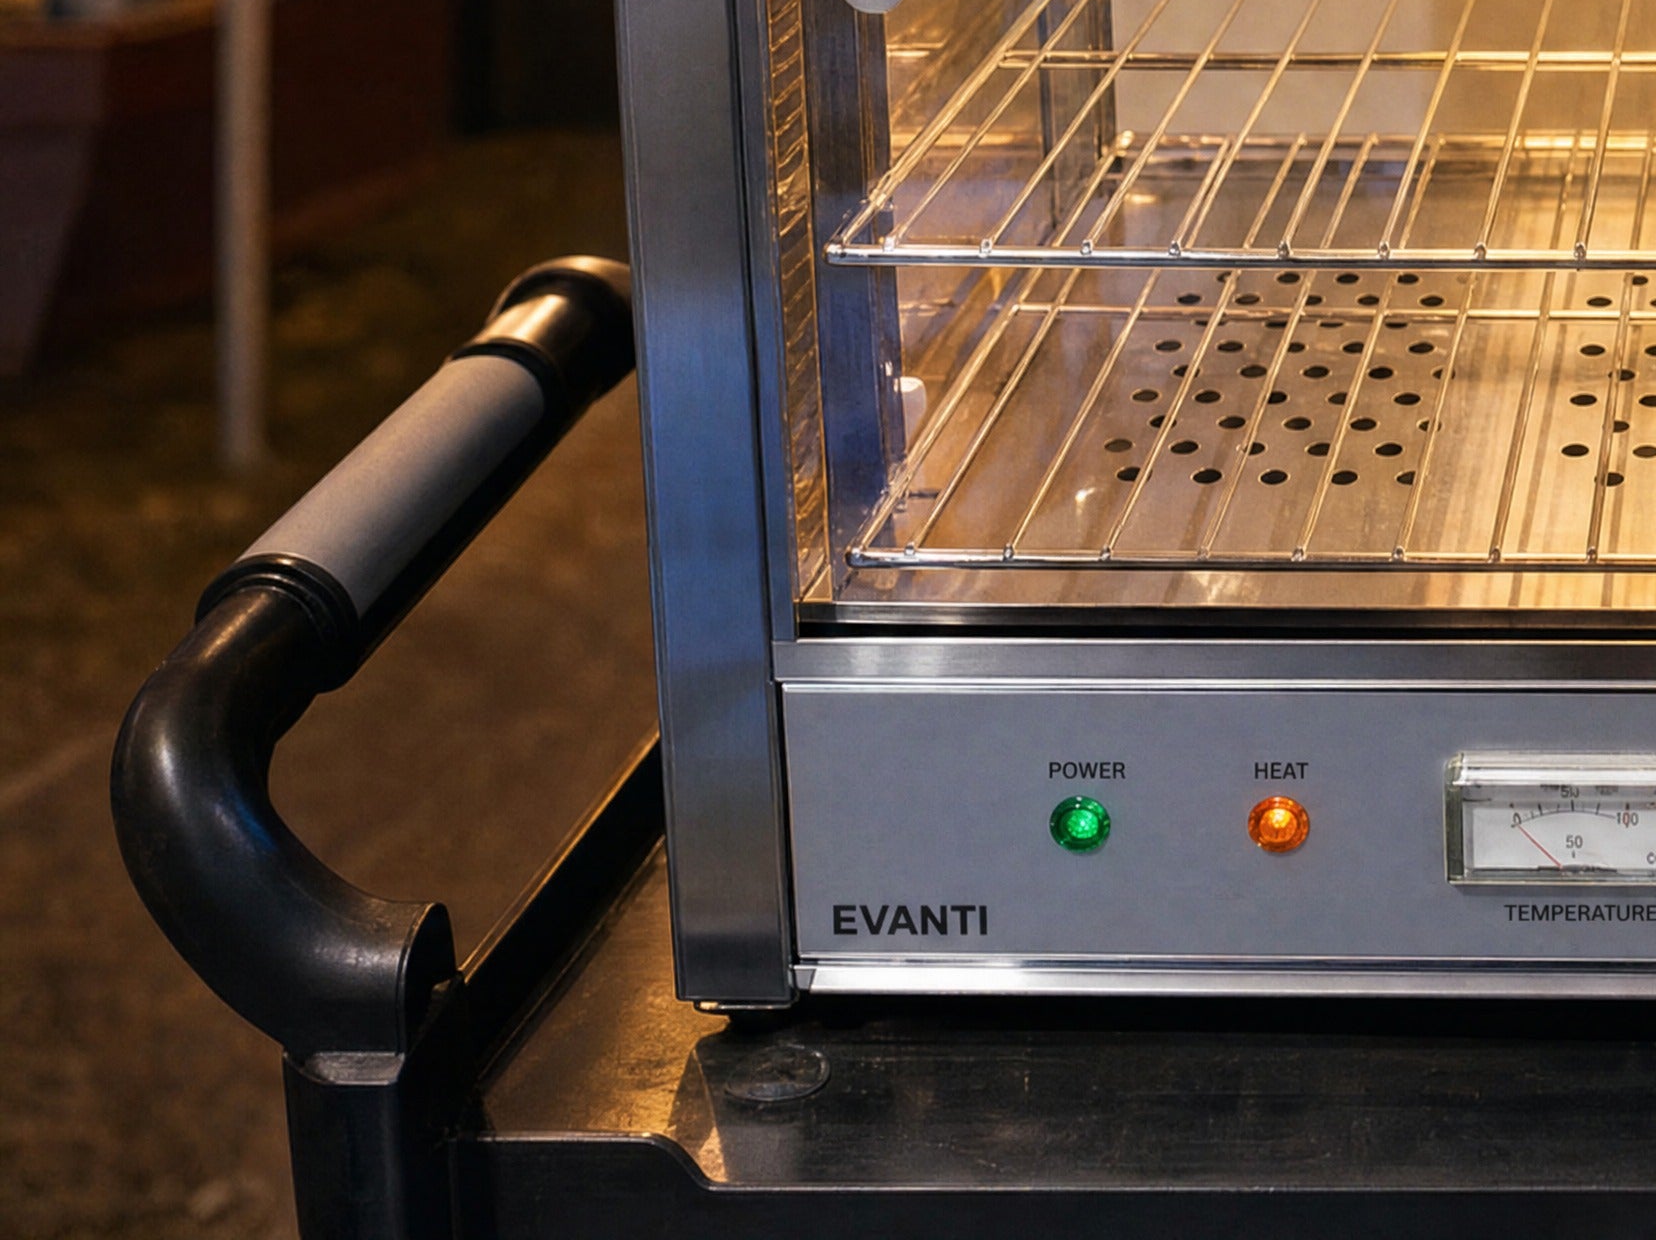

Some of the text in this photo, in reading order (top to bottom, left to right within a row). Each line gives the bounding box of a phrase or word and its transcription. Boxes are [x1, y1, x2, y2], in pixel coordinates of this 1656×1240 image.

[1048, 761, 1126, 780] POWER
[1254, 761, 1309, 780] HEAT
[1616, 812, 1639, 827] 100
[1565, 834, 1583, 849] 50
[832, 904, 988, 936] EVANTI
